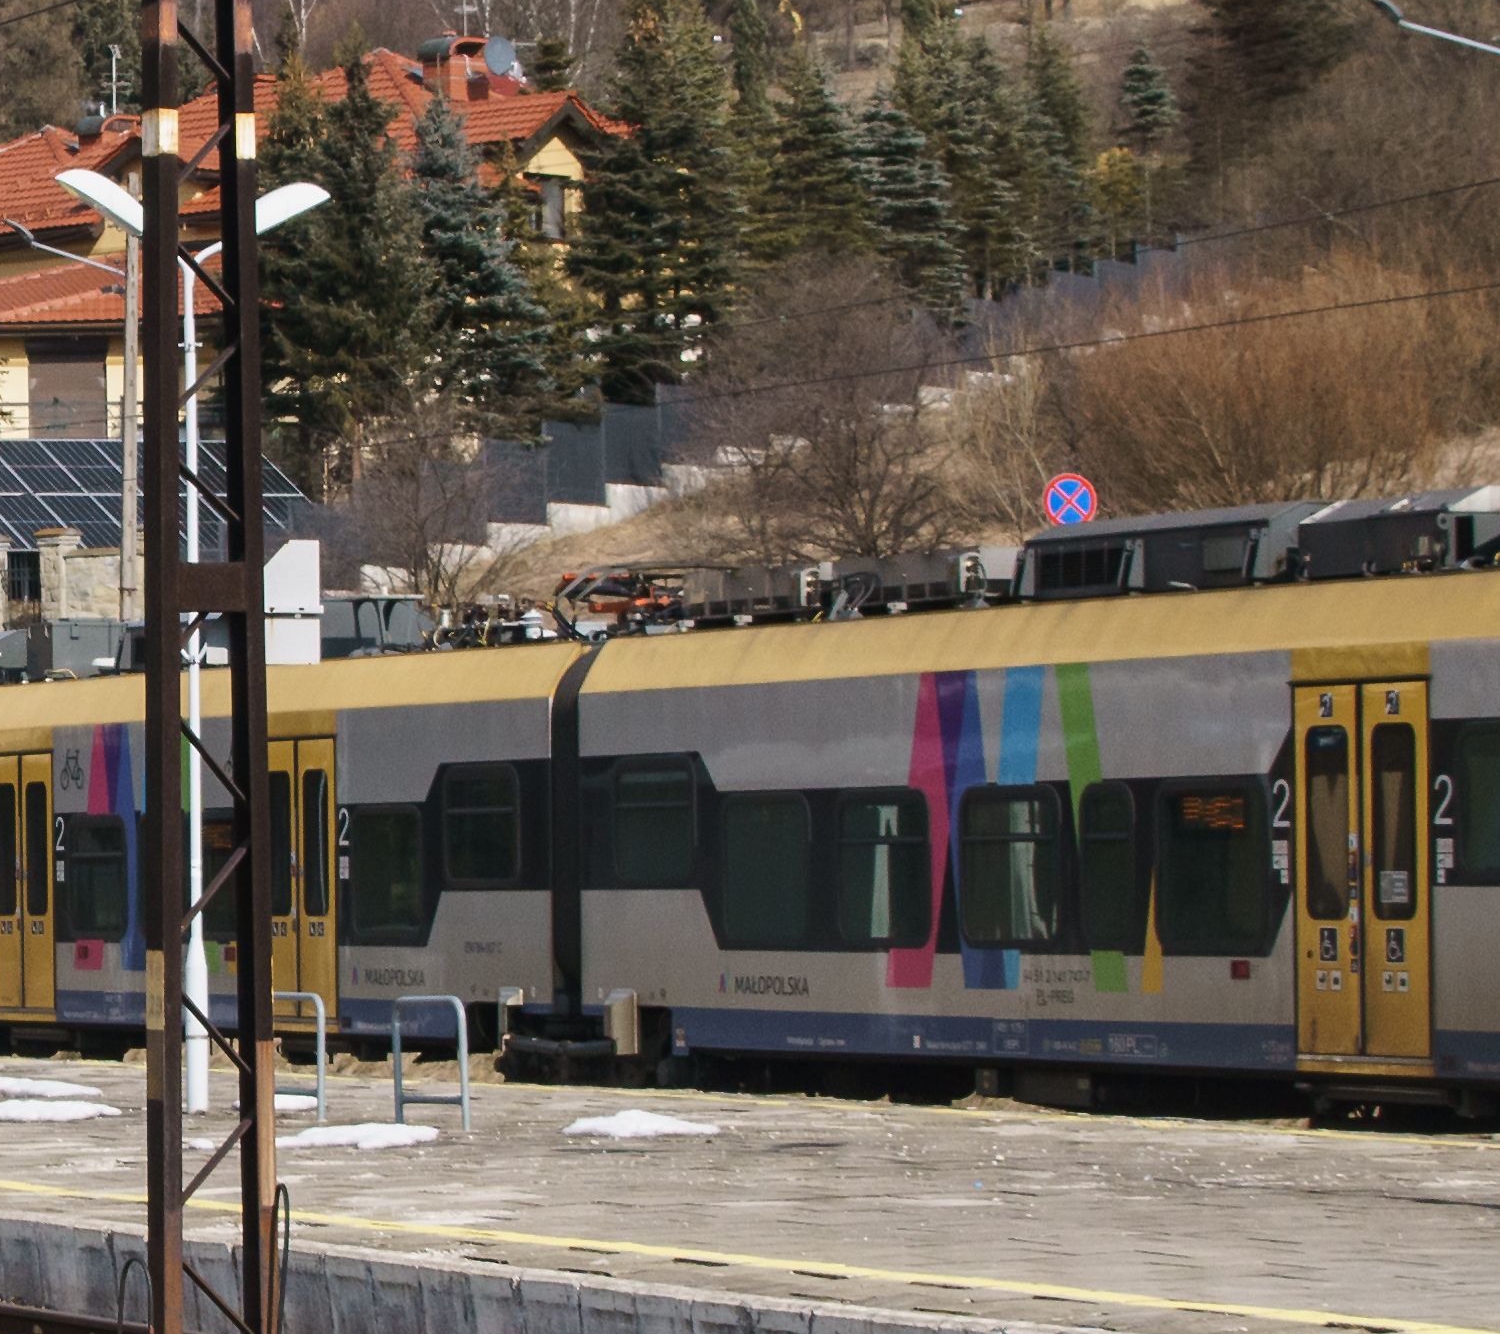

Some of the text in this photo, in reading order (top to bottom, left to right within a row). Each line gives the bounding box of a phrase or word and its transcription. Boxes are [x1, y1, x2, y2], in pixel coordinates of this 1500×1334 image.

[1272, 777, 1291, 828] 2
[1433, 774, 1454, 825] 2
[55, 816, 65, 851] 2
[338, 807, 350, 846] 2
[364, 968, 426, 987] MAŁOPOLSKA
[734, 975, 810, 997] MAŁOPOLSKA
